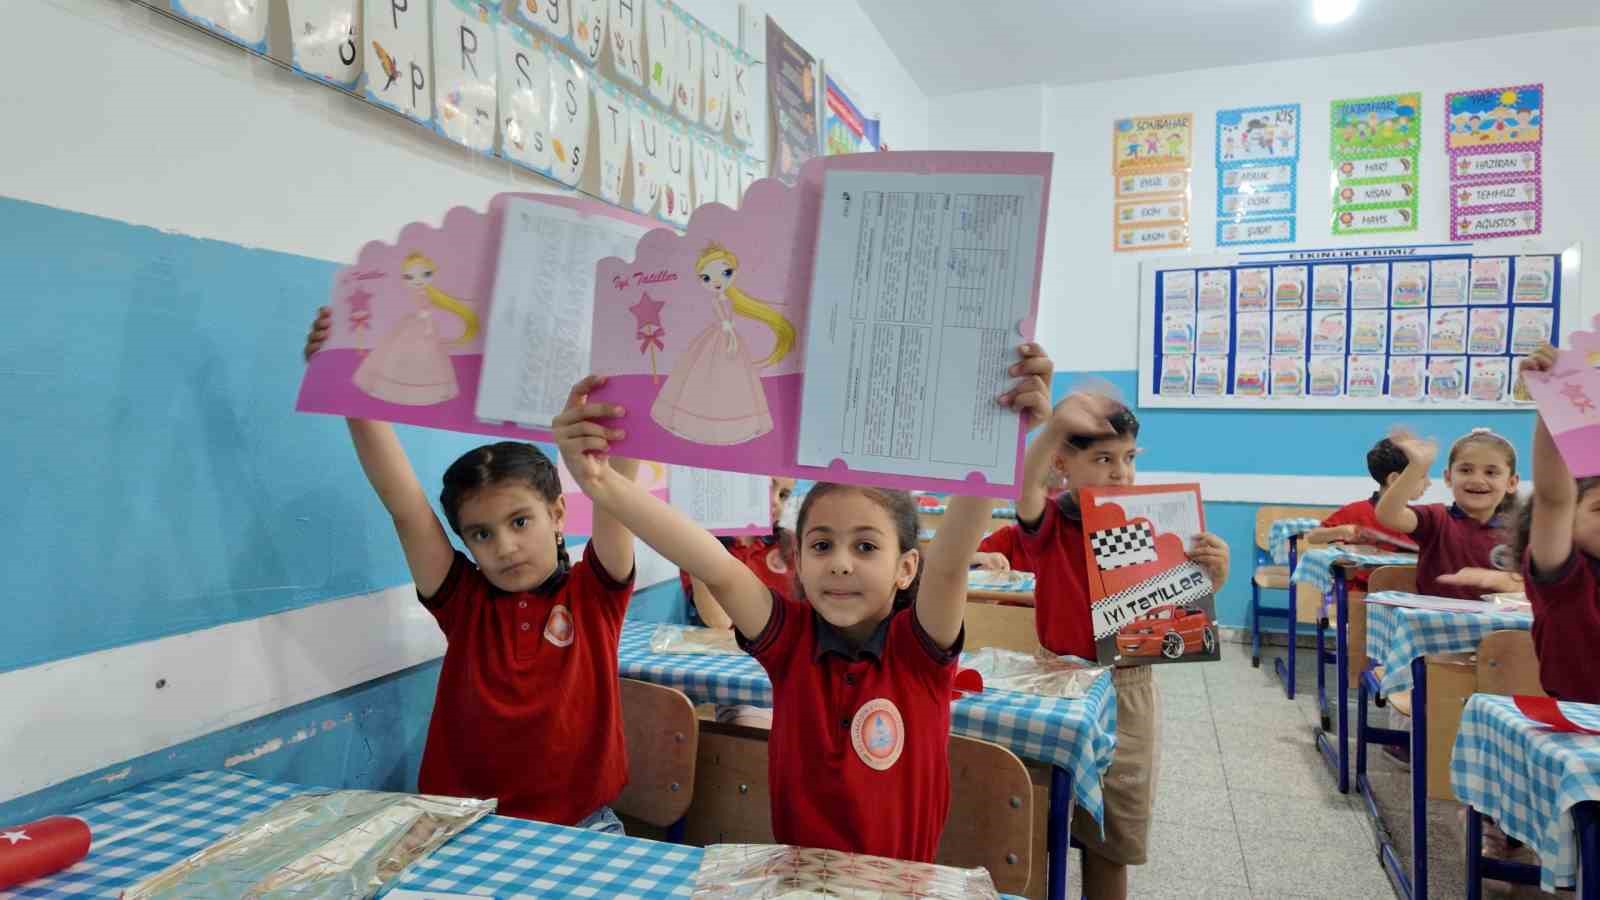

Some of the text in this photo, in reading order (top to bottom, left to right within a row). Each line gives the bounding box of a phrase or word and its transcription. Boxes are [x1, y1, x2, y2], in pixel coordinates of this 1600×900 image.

[459, 25, 479, 80] R
[410, 61, 425, 109] p
[607, 104, 620, 144] T
[641, 120, 657, 158] U
[1136, 117, 1190, 132] SONBAHAR
[1476, 187, 1517, 201] TEMMUZ
